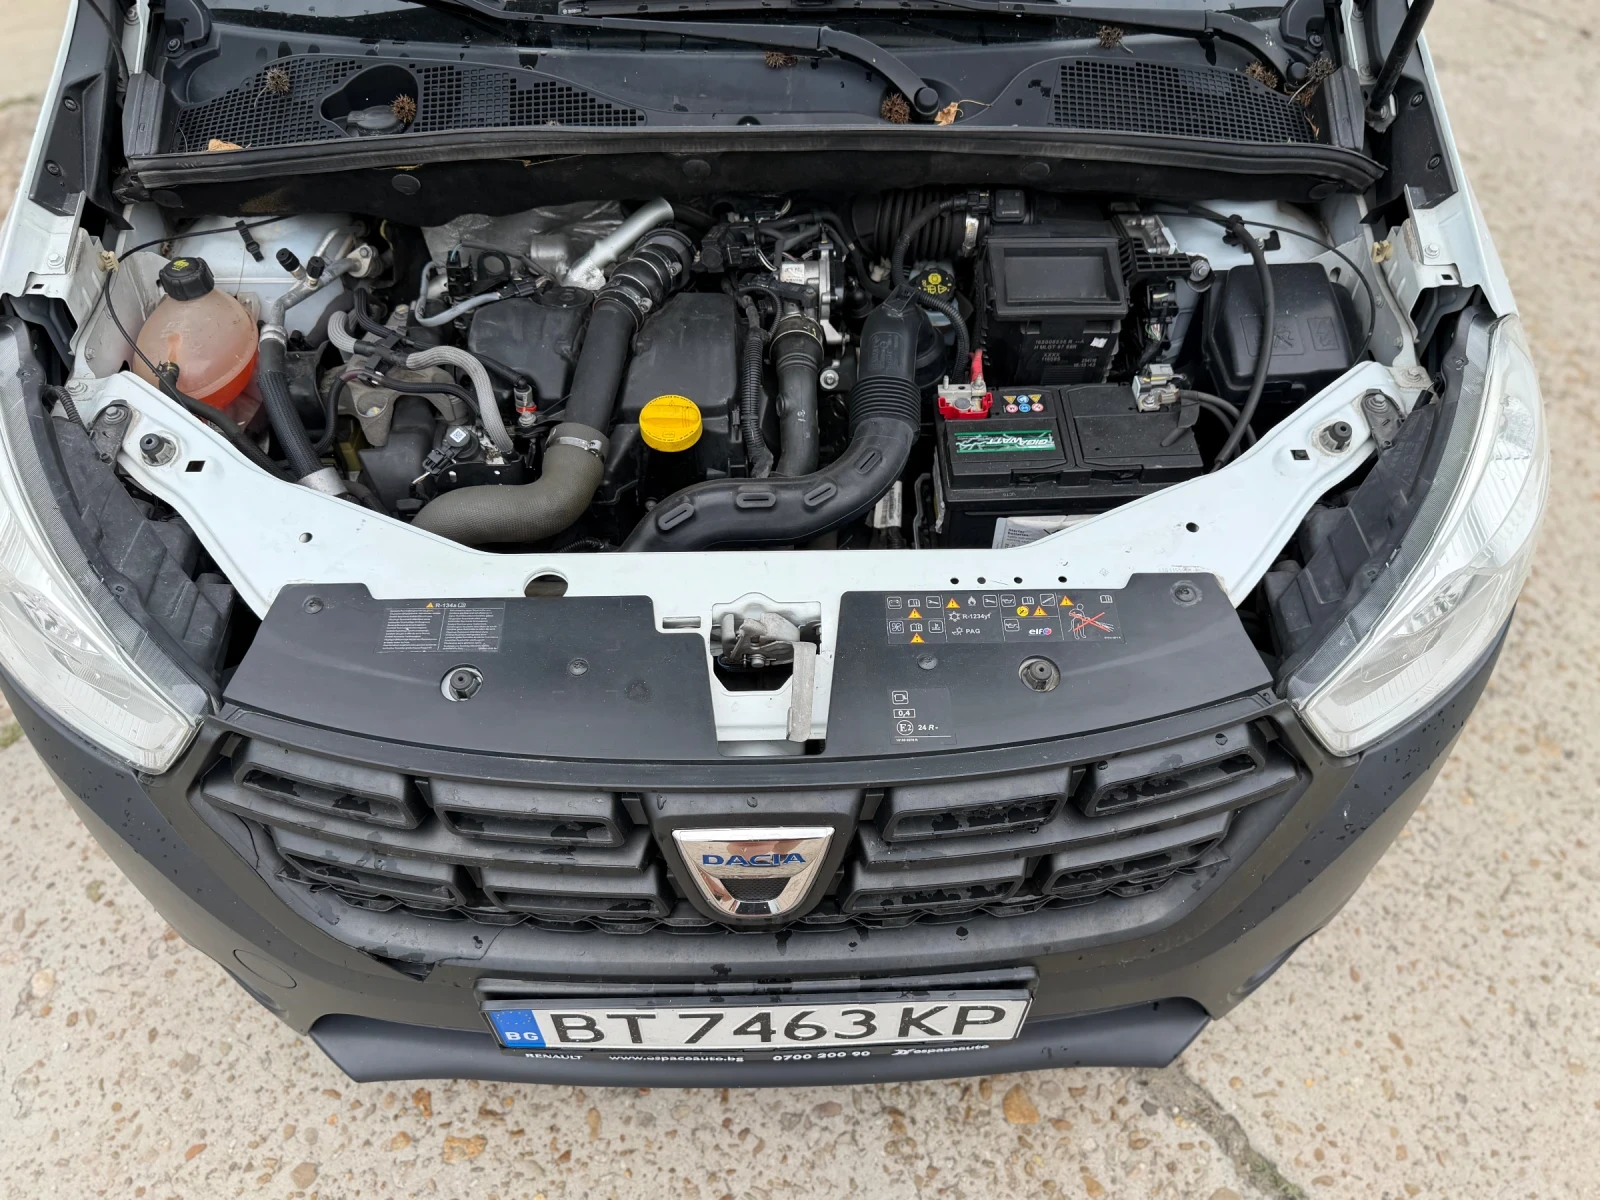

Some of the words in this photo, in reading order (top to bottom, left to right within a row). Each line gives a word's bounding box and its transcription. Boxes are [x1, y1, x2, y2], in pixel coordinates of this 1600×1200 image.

[962, 612, 992, 620] R-1234yf
[1028, 628, 1044, 636] elf
[898, 710, 910, 718] 0,4
[702, 852, 806, 867] DACIA
[504, 1031, 539, 1041] BG
[550, 1013, 656, 1045] BT
[678, 1009, 878, 1044] 7463
[898, 1005, 1006, 1037] KP
[772, 1054, 812, 1062] 0700
[817, 1051, 847, 1059] 200
